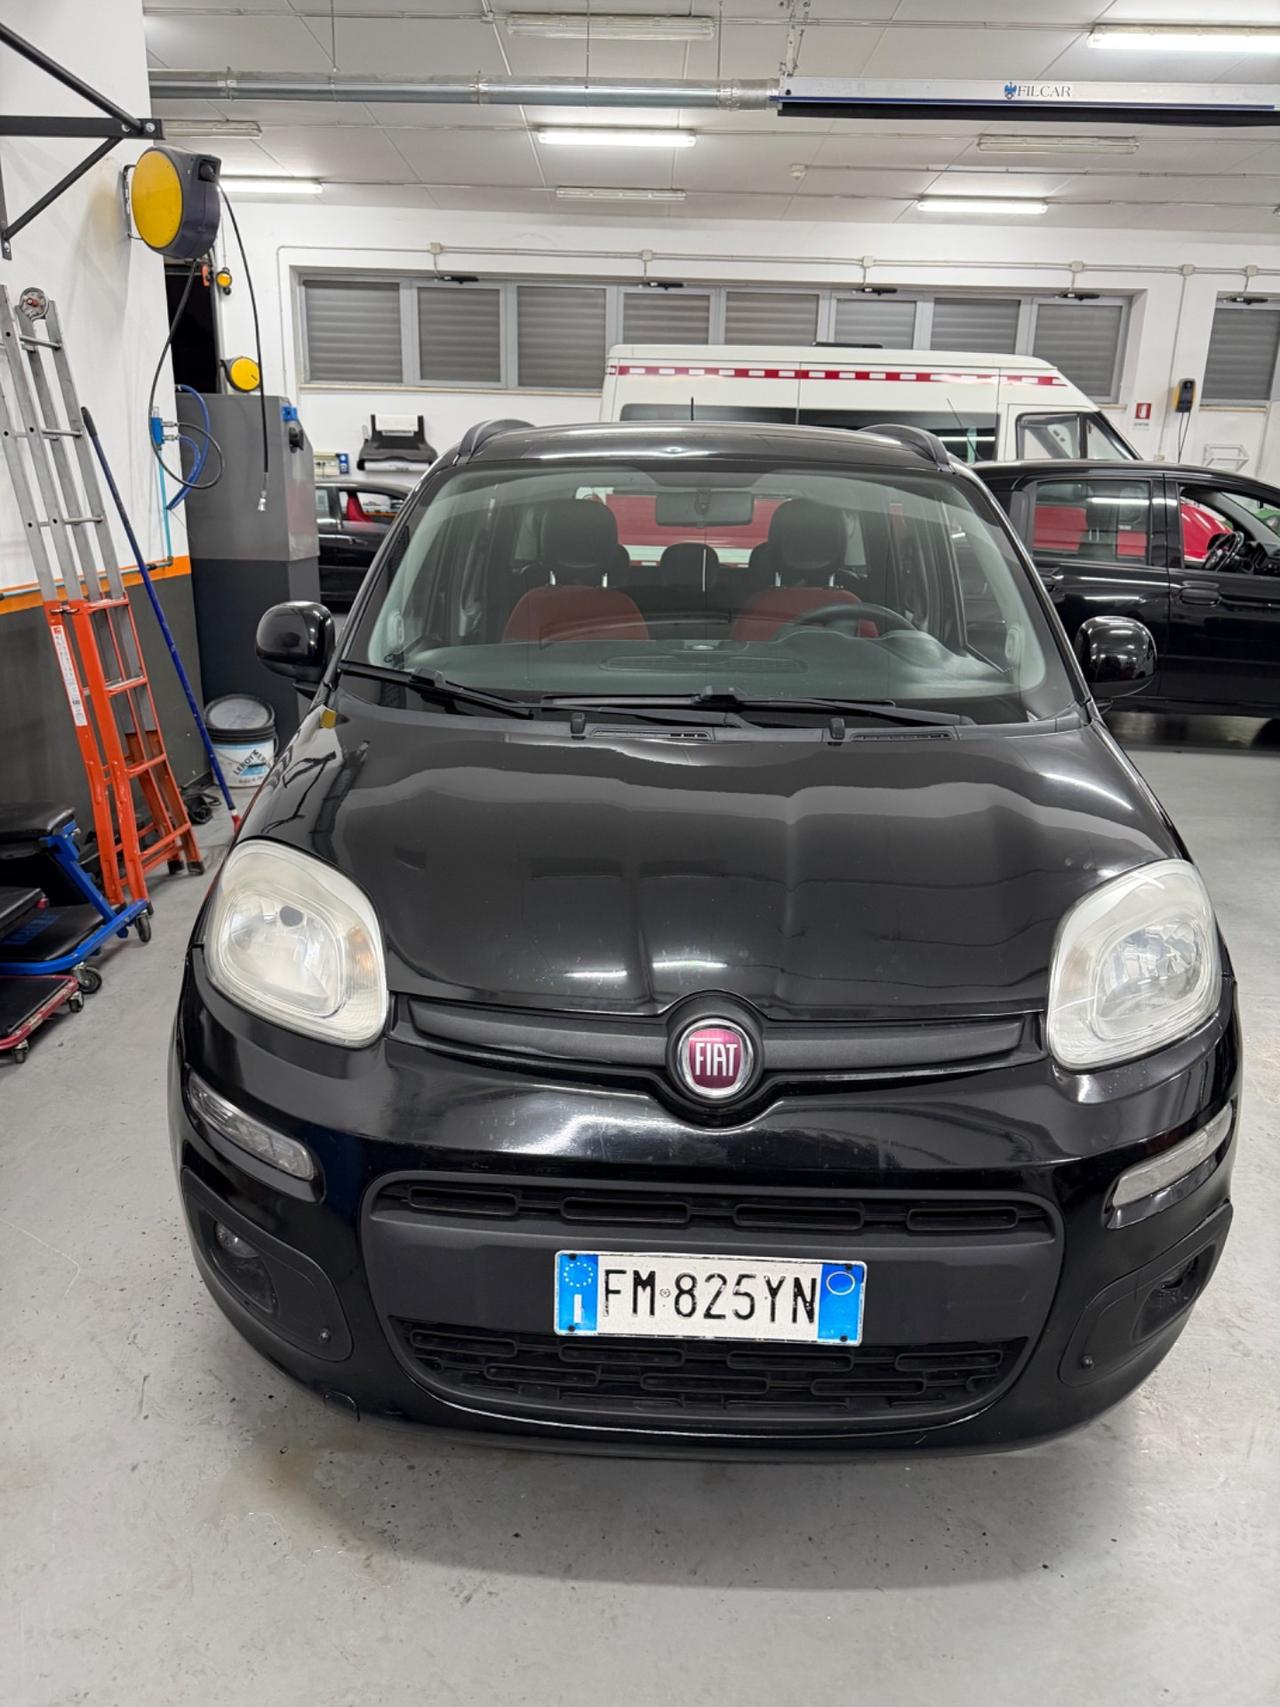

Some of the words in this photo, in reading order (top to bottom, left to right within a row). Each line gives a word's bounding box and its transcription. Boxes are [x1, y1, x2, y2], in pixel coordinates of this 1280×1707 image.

[1017, 85, 1071, 98] FILCAR
[232, 753, 255, 776] LEROY
[694, 1042, 738, 1077] FIAT
